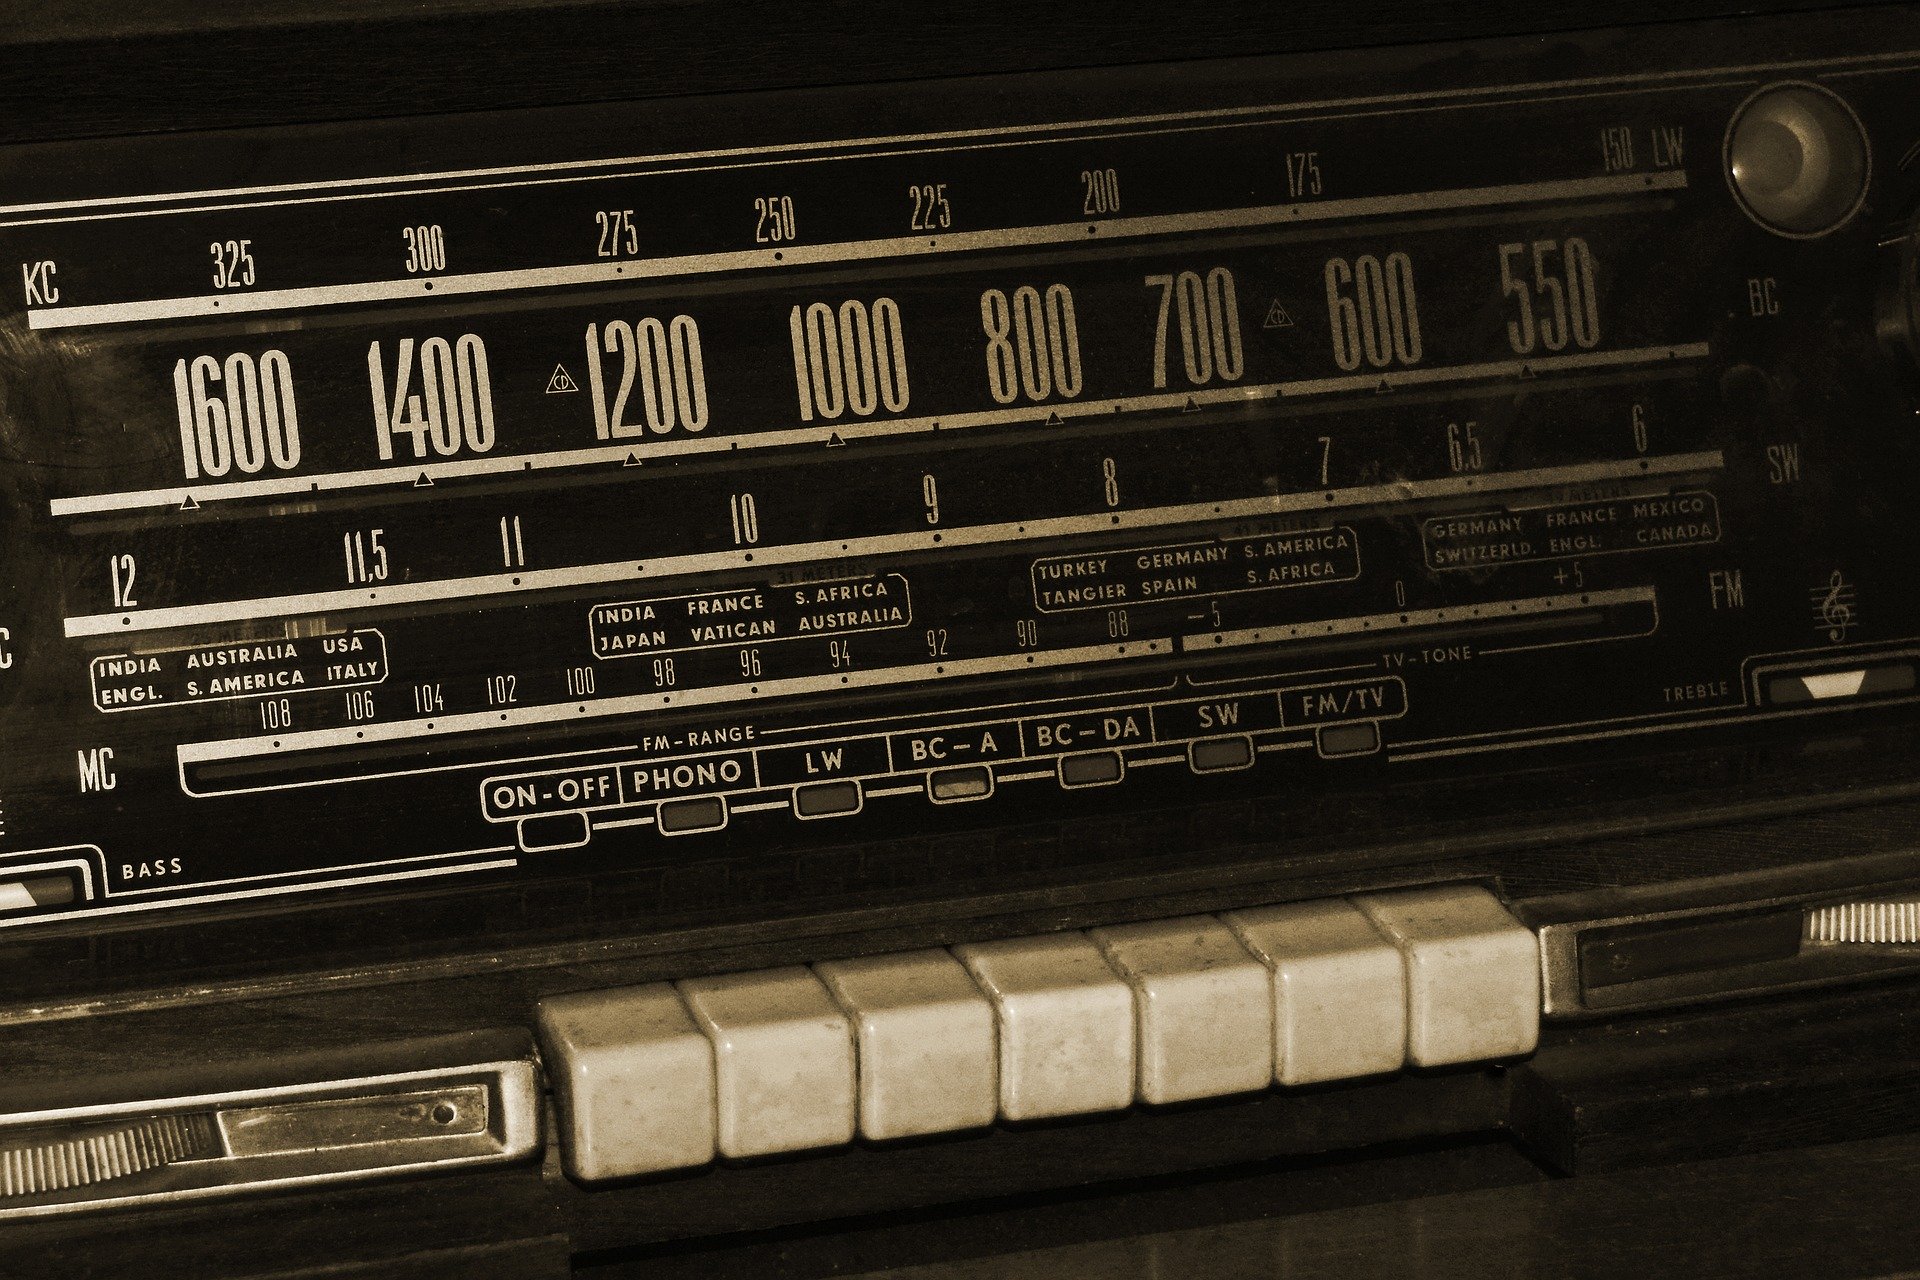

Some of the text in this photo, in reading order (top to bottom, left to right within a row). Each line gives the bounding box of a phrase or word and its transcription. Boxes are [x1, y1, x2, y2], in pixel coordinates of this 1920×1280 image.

[23, 261, 59, 305] KC
[211, 240, 255, 288] 325
[403, 225, 445, 272] 300
[596, 210, 638, 256] 275
[755, 196, 795, 242] 250
[910, 184, 950, 230] 225
[1082, 169, 1119, 214] 200
[1287, 153, 1321, 197] 175
[1652, 127, 1682, 166] LW
[1748, 278, 1778, 316] BC
[174, 350, 300, 479] 1600
[368, 334, 495, 460] 1400
[586, 315, 708, 439] 1200
[790, 298, 909, 421] 1000
[981, 284, 1082, 403] 800
[1145, 268, 1243, 388] 700
[1325, 253, 1422, 370] 600
[1499, 238, 1599, 353] 550
[111, 555, 137, 607] 12
[345, 529, 387, 583] 11,5
[501, 516, 524, 566] 11
[731, 494, 757, 544] 10
[924, 475, 938, 523] 9
[1104, 458, 1118, 506] 8
[1319, 437, 1330, 484] 7
[1633, 405, 1646, 452] 6
[1767, 444, 1798, 483] SW
[1432, 499, 1703, 538] GERMANY FRANCE MEXICO
[1038, 535, 1347, 579] TURKEY GERMANY S. AMERICA
[1550, 536, 1602, 552] ENGL.
[1637, 523, 1714, 544] CANADA
[1043, 545, 1334, 604] TANGIER SPAIN S. AFRICA
[1710, 570, 1743, 609] FM
[599, 583, 887, 623] INDIA FRANCE S. AFRICA
[601, 607, 904, 650] JAPAN VATICAN AUSTRALIA
[98, 637, 362, 677] INDIA AUSTRALIA USA
[1383, 646, 1470, 668] TV-TONE
[78, 610, 1128, 792] MC 108 106 104 102 100 98 96 94 92 90 88
[102, 662, 377, 704] ENGL. S. AMERICA ITALY
[1664, 682, 1727, 701] TREBLE
[493, 776, 611, 811] ON-OFF
[633, 759, 742, 793] PHONO
[806, 749, 842, 773] LW
[1199, 703, 1238, 727] SW
[1303, 687, 1382, 716] FM/TV
[642, 725, 755, 752] FM-RANGE
[123, 858, 181, 879] BASS
